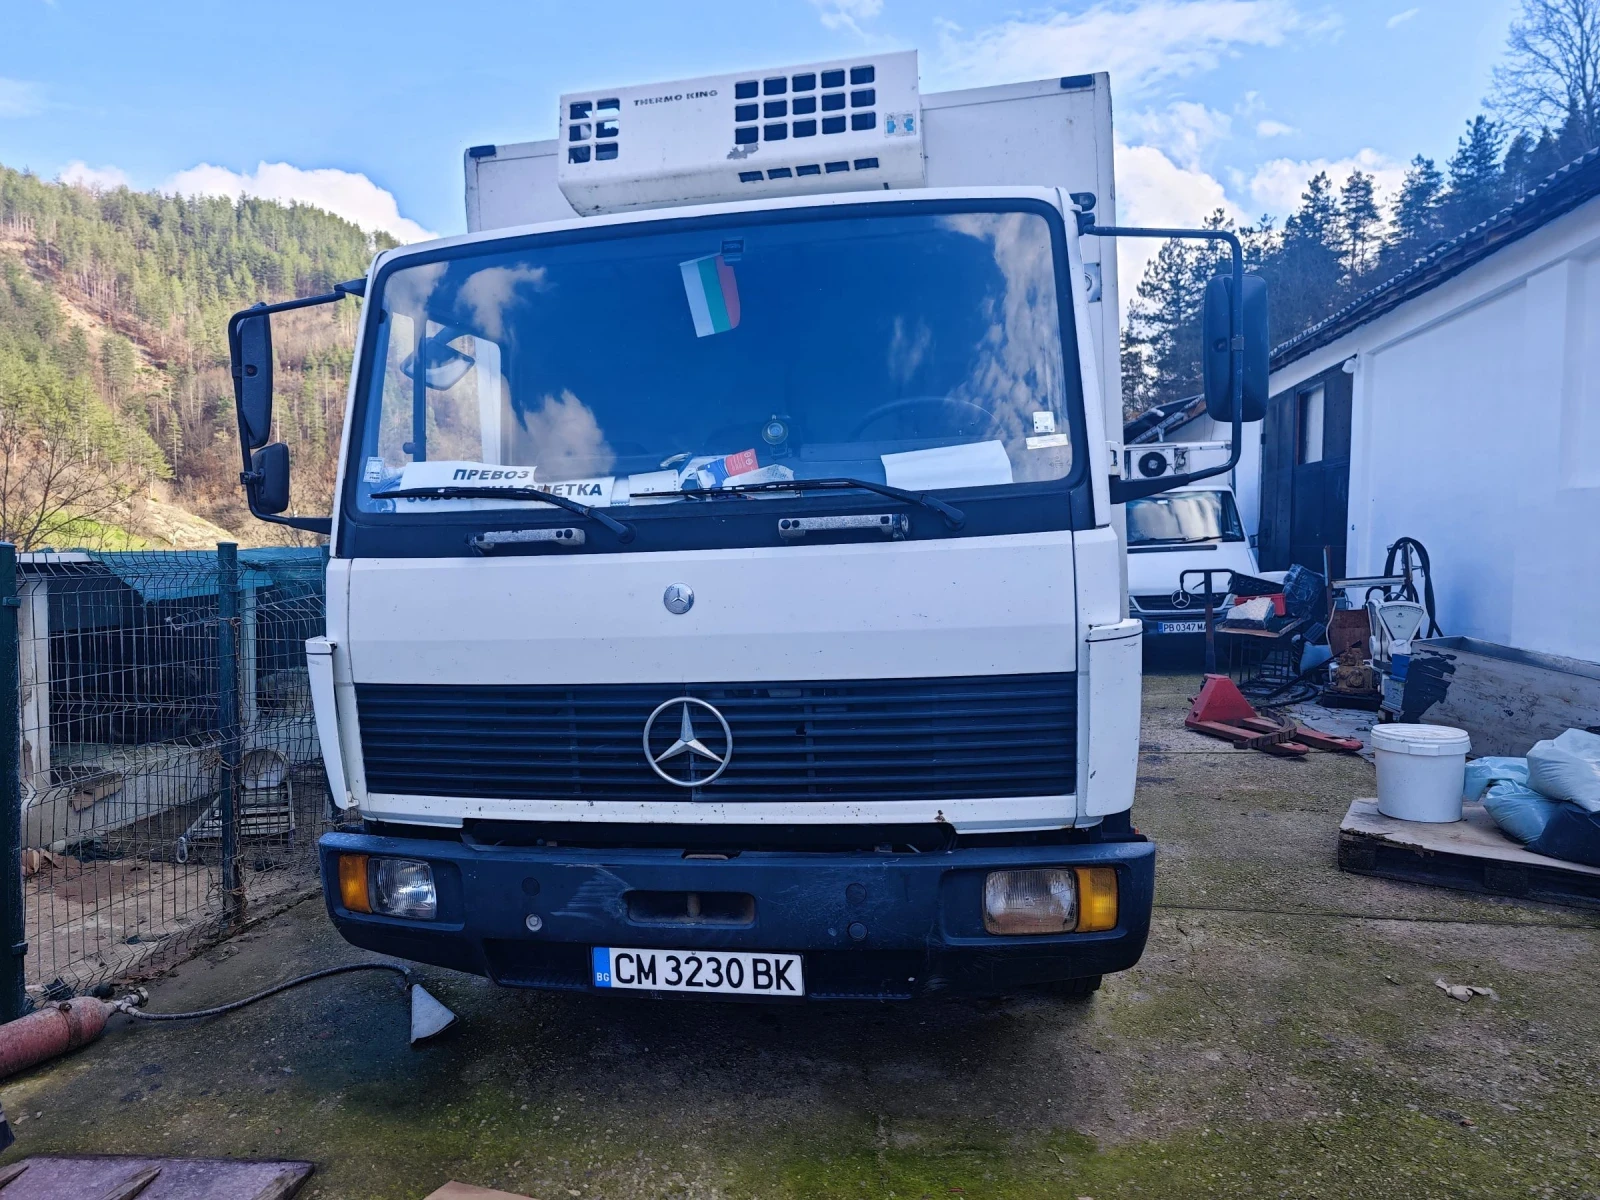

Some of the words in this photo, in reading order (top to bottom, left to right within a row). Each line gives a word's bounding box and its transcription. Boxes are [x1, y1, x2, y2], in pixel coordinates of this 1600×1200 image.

[633, 94, 683, 106] THERMO
[686, 89, 718, 100] KING
[452, 468, 530, 481] ПРЕВОЗ
[1175, 623, 1196, 632] 0347
[596, 971, 610, 982] BG
[614, 953, 657, 986] CM
[664, 955, 745, 988] 3230
[751, 957, 796, 991] BK
